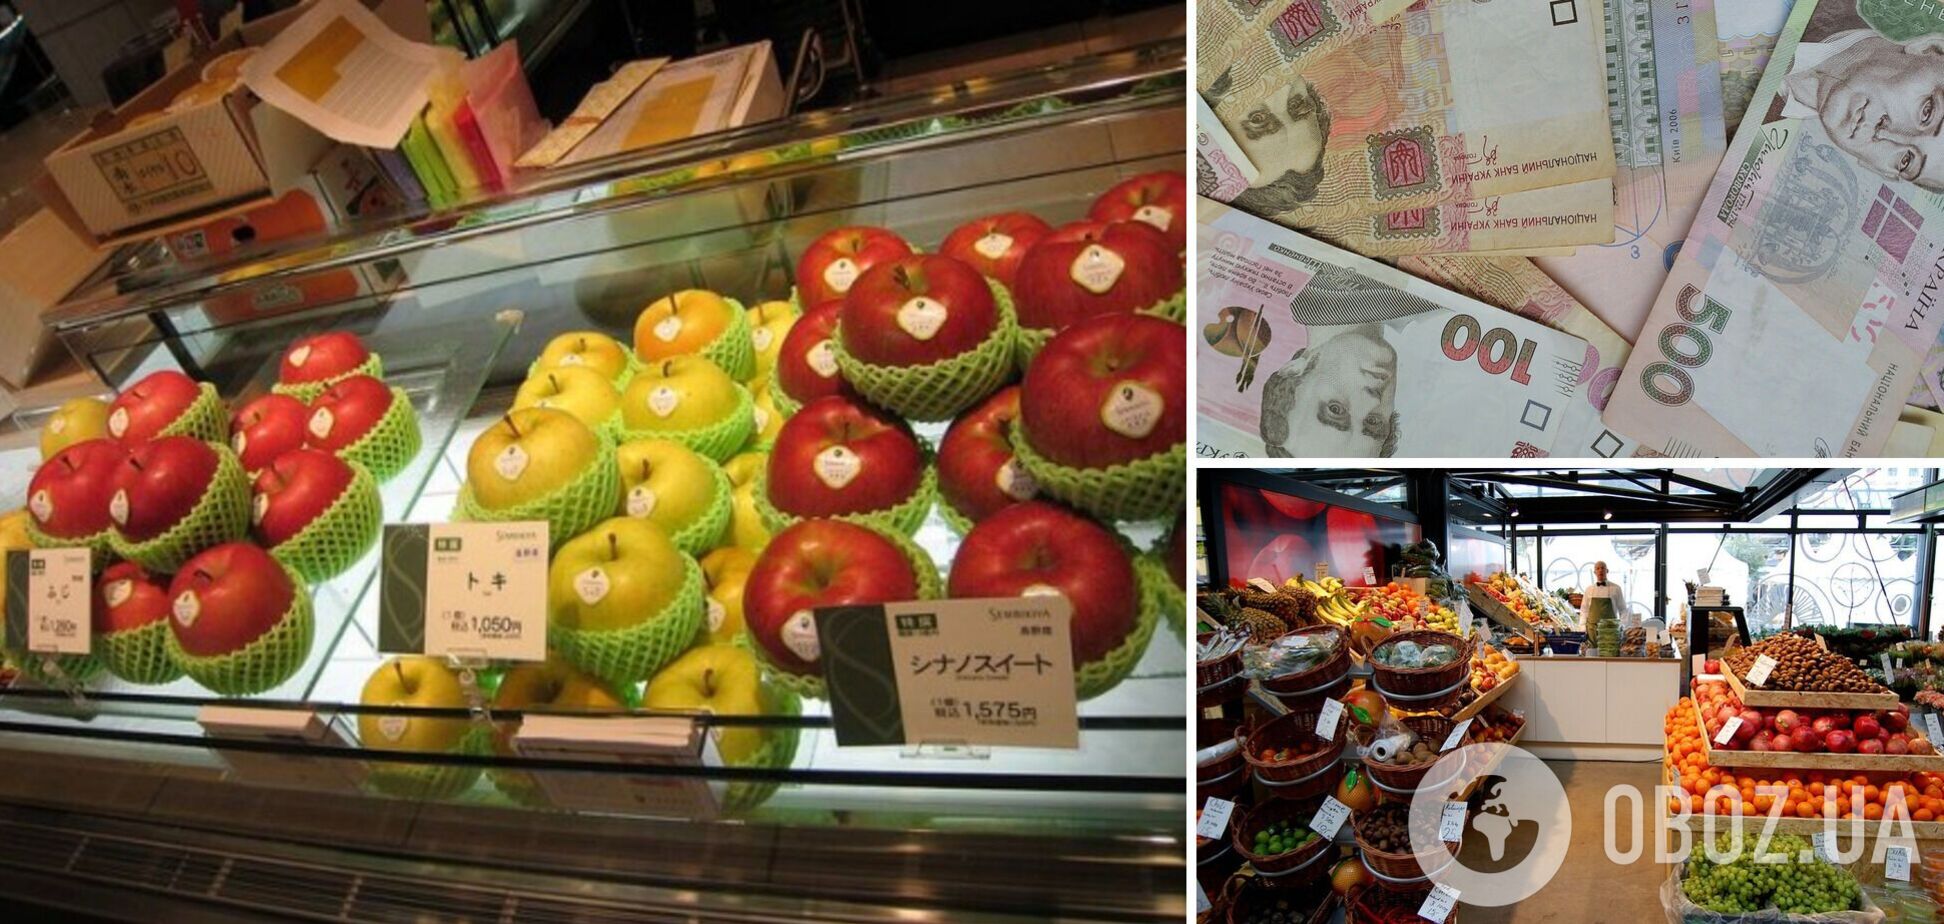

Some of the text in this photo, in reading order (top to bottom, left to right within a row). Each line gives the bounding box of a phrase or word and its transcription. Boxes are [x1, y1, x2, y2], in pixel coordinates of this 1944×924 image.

[1669, 108, 1681, 164] Київ 2006
[1451, 152, 1597, 185] НАЦІОНАЛЬНИЙ БАНК УКРАЇНИ
[1450, 213, 1597, 232] НАЦІОНАЛЬНИЙ БАНК УКРАЇНИ
[1440, 314, 1538, 386] 100
[1640, 283, 1732, 407] 500
[1855, 362, 1899, 438] НАЦІОНАЛЬНИЙ
[468, 571, 507, 591] トキ
[910, 652, 1054, 676] シナノスイート
[962, 700, 1037, 721] 1,575円
